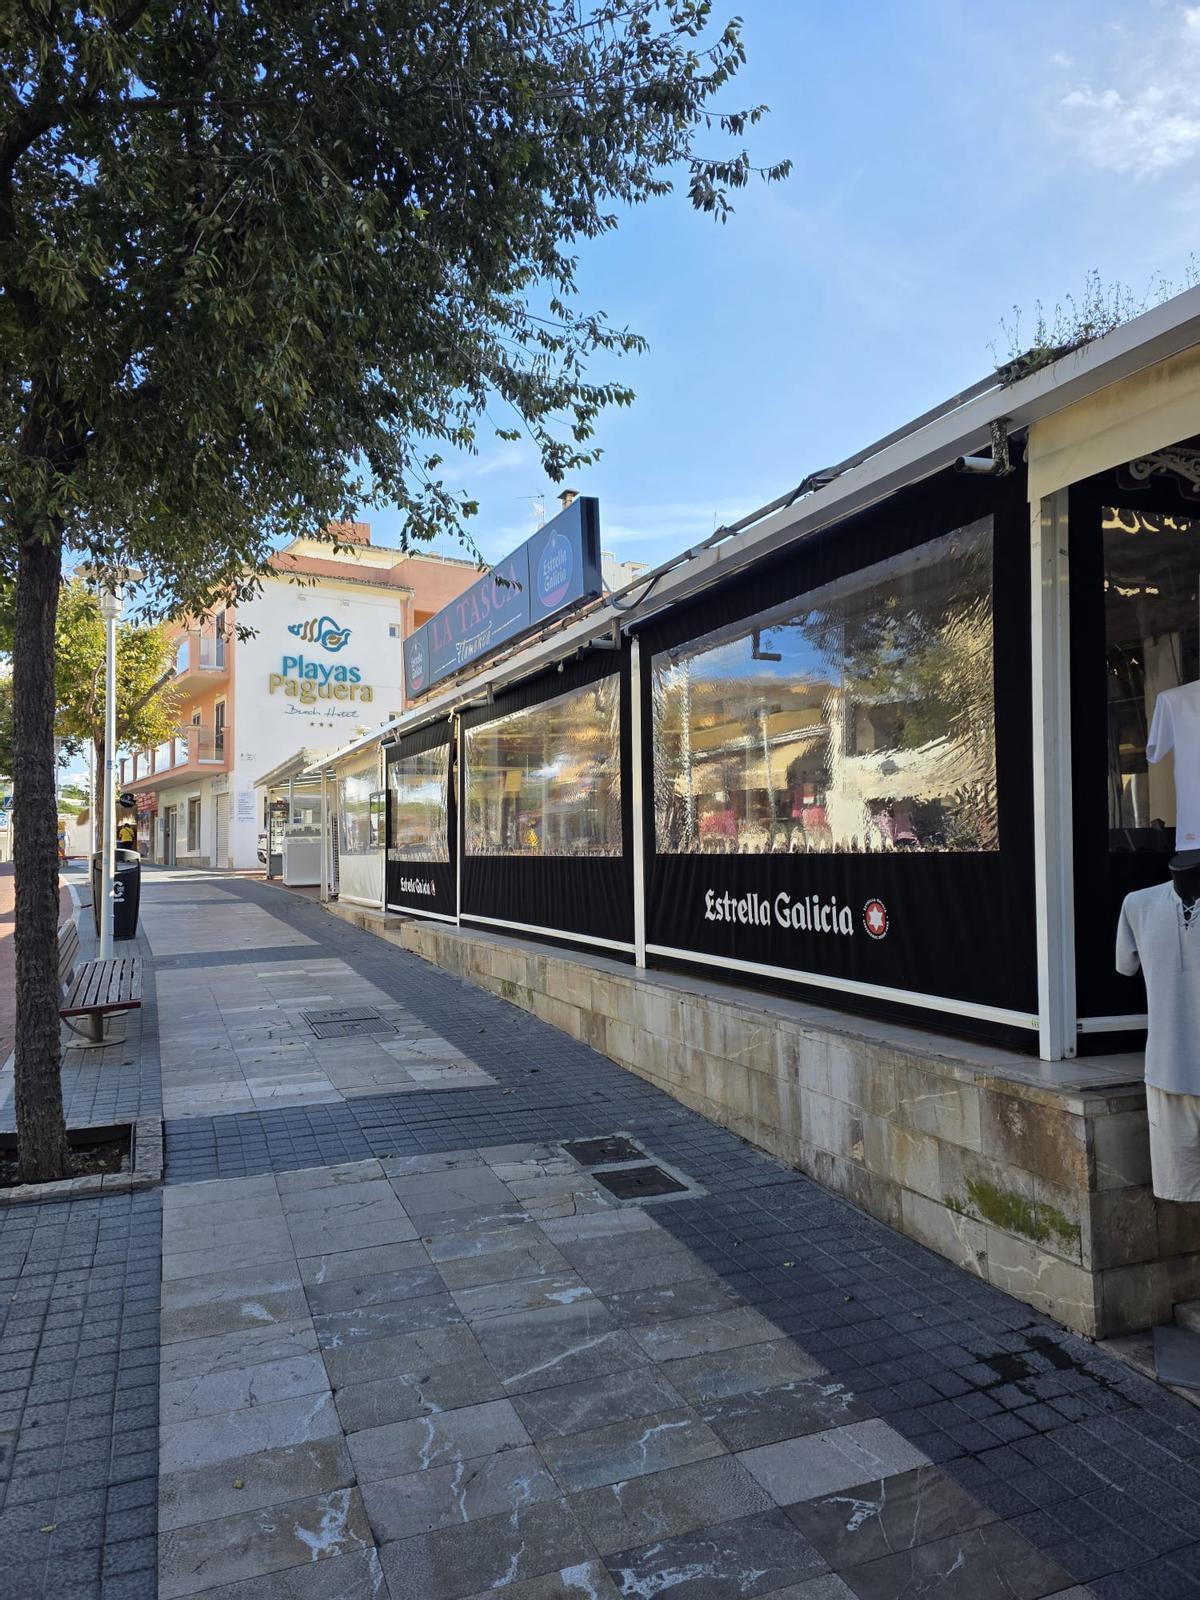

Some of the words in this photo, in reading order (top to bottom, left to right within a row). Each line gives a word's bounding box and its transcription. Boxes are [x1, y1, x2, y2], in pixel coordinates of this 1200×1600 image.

[431, 616, 453, 652] LA
[456, 561, 521, 633] TASCA
[268, 672, 374, 704] Paguera
[282, 655, 361, 687] Playas
[704, 888, 771, 927] Estrella
[774, 891, 855, 936] Galicia
